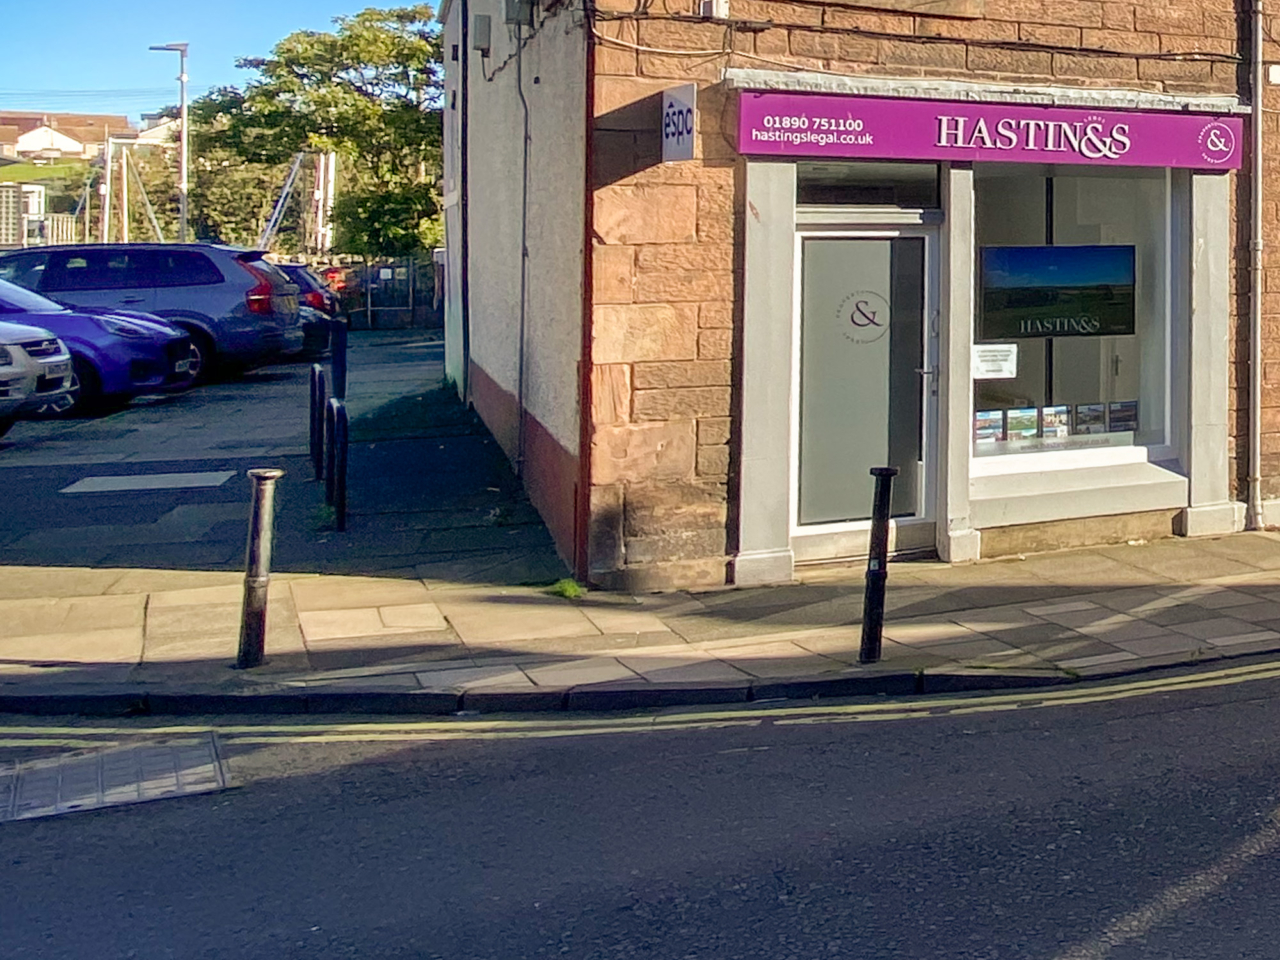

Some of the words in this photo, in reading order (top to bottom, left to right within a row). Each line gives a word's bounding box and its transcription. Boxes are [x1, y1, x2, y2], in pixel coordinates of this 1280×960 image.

[763, 116, 808, 129] 01890
[812, 118, 863, 131] 751100
[752, 128, 873, 146] hastingslegal.co.uk
[936, 115, 1131, 159] HASTIN&S
